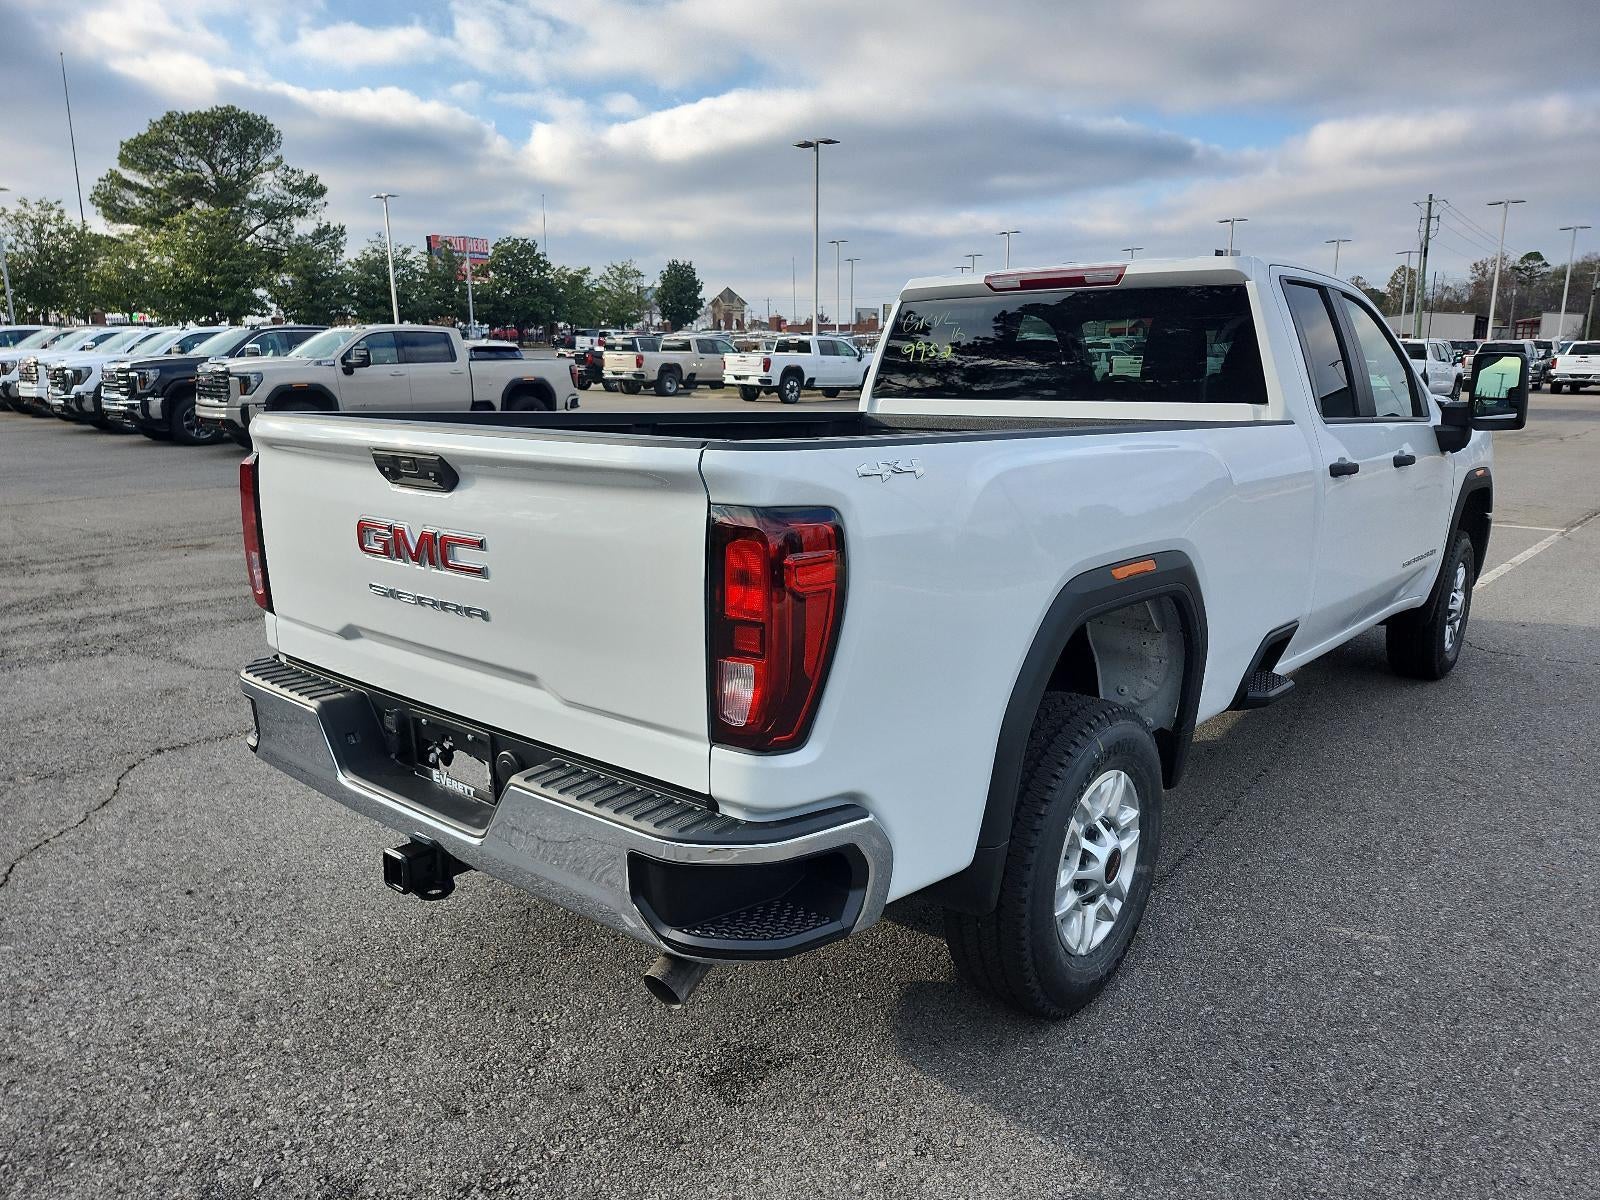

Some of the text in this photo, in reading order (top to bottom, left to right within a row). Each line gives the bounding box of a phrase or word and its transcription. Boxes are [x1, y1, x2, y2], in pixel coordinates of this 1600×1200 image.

[356, 515, 490, 582] GMC
[368, 582, 491, 622] SIERRA
[432, 768, 476, 797] EVERETT
